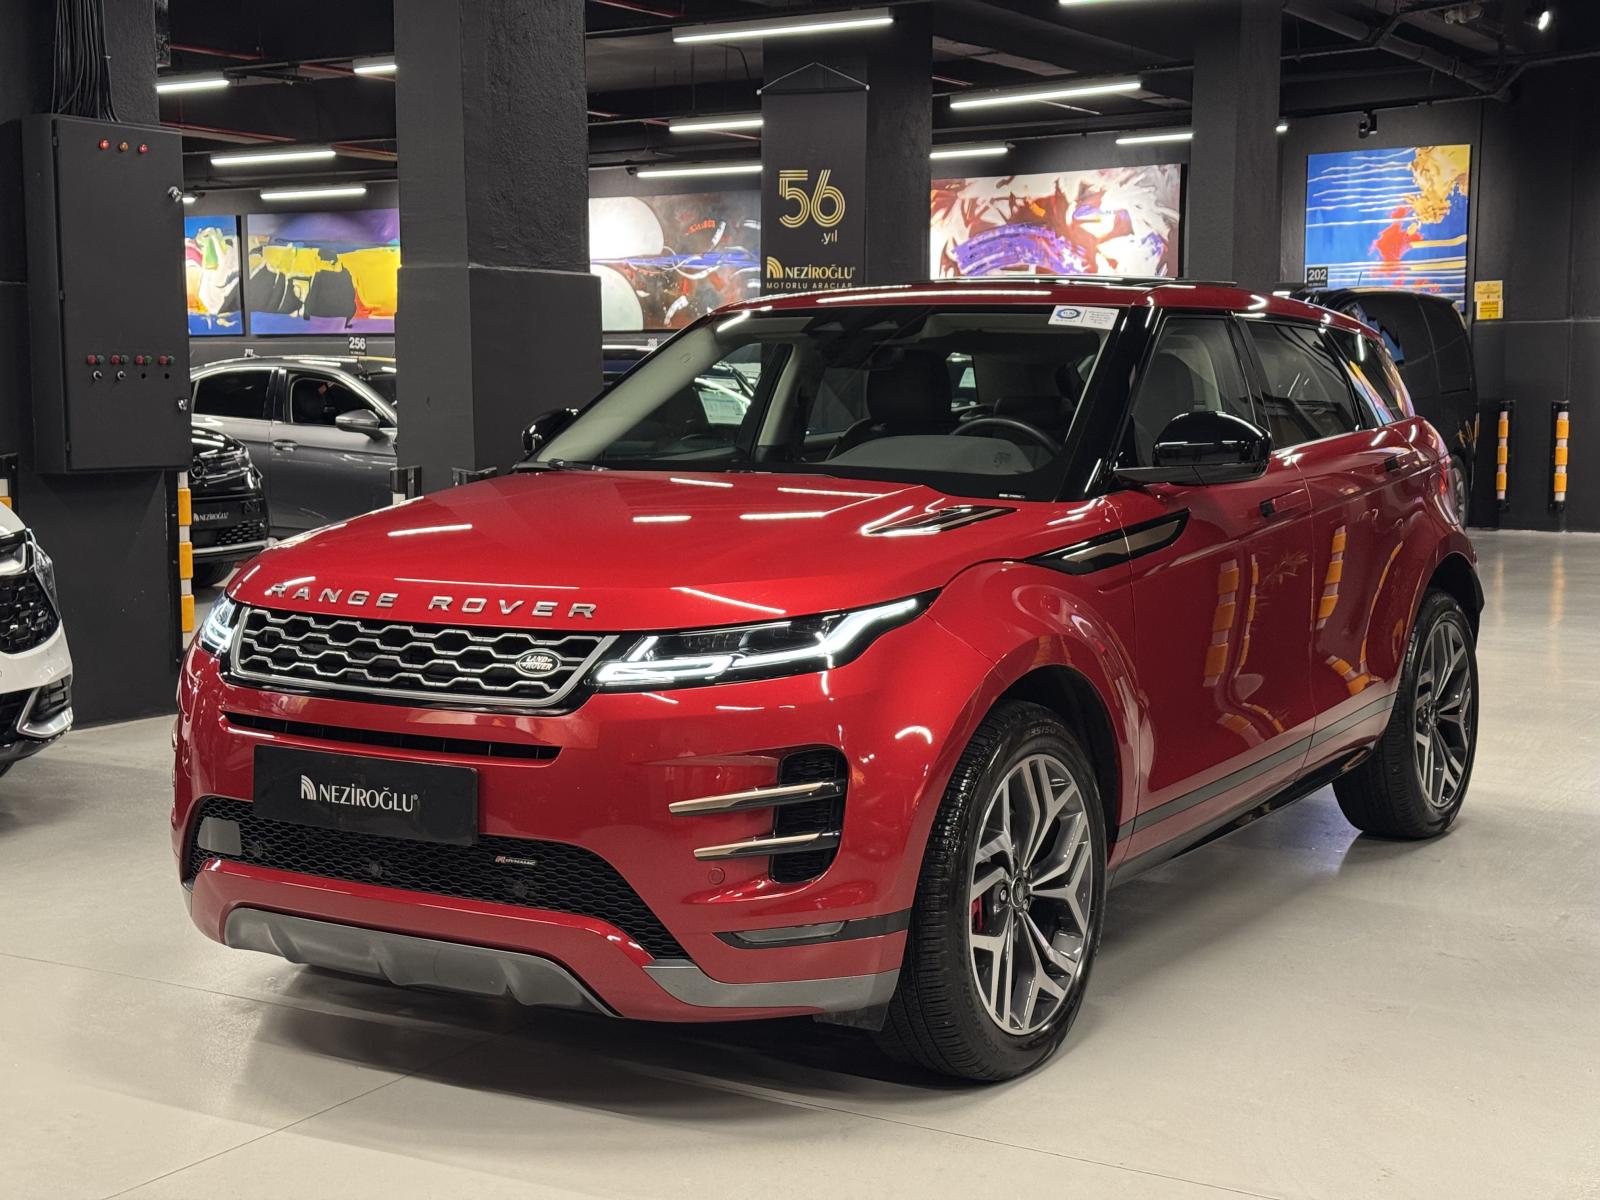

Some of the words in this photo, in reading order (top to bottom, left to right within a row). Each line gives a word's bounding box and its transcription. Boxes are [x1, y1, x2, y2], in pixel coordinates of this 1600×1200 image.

[779, 169, 846, 228] 56
[785, 264, 853, 279] NEZİROĞLU
[1308, 268, 1327, 281] 202
[349, 336, 366, 350] 256
[268, 583, 399, 607] RANGE
[427, 595, 597, 619] ROVER
[319, 783, 414, 813] NEZİROĞLU
